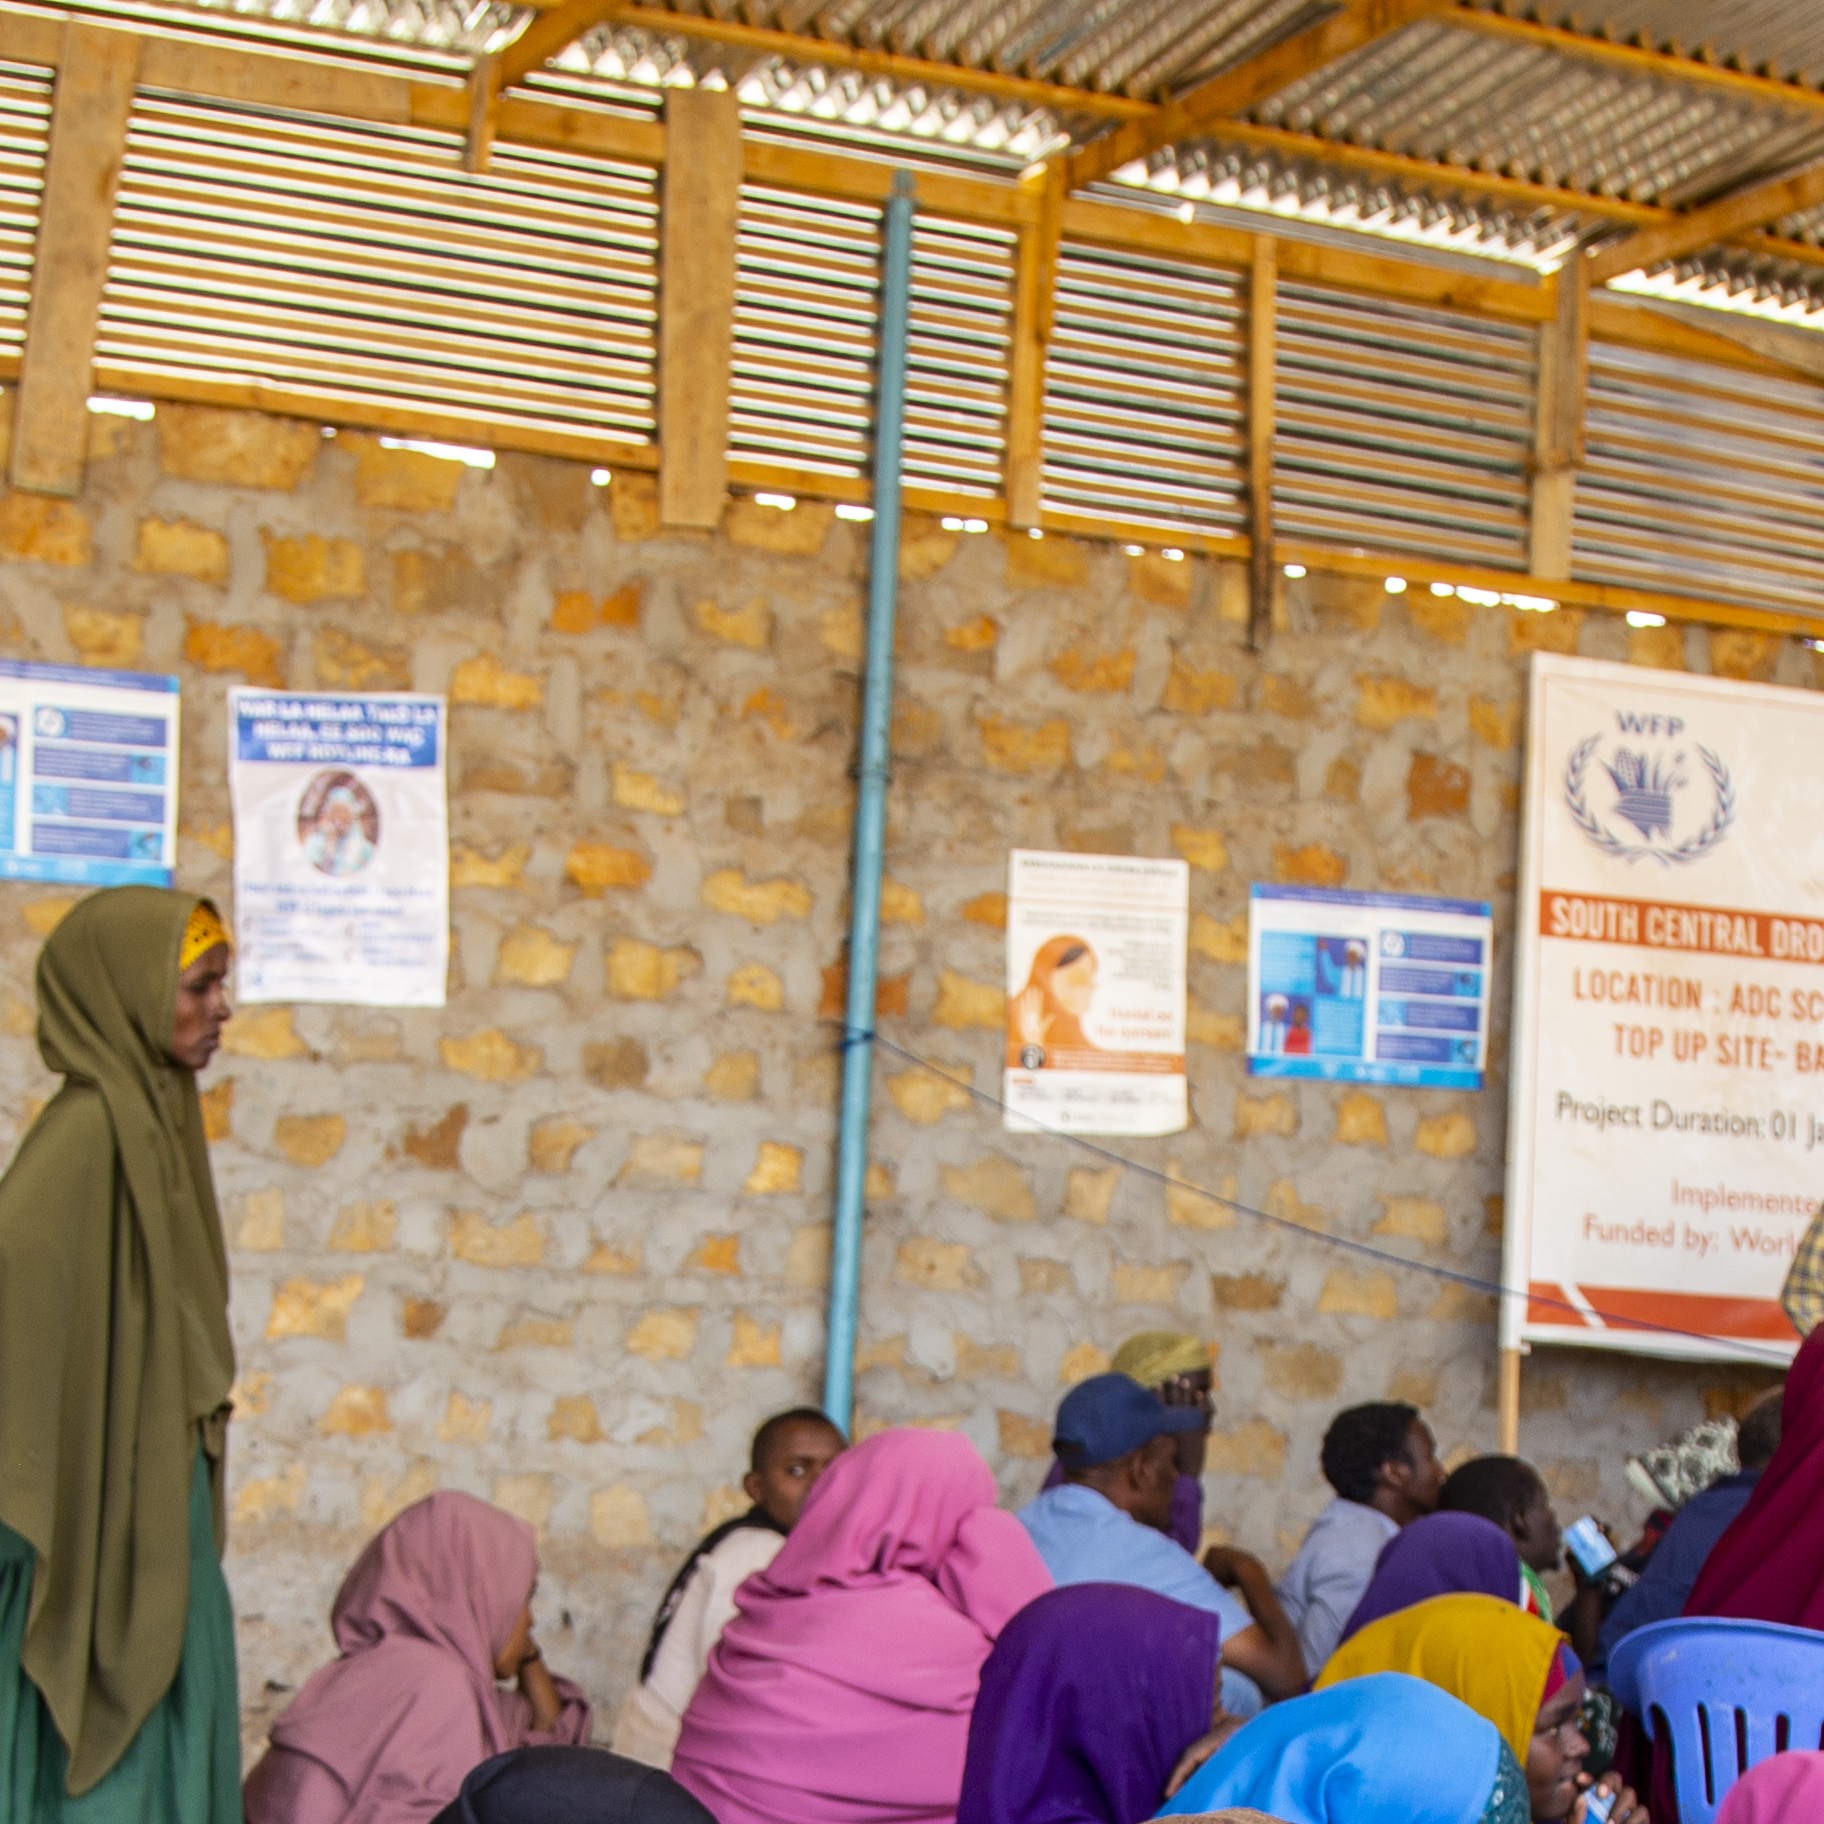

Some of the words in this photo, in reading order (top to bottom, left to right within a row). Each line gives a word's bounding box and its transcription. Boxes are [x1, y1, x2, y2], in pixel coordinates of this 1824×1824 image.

[1616, 710, 1685, 738] WFP
[1550, 897, 1638, 942] SOUTH
[1646, 906, 1763, 956] CENTRAL
[1574, 968, 1702, 1009] LOCATION
[1730, 984, 1781, 1020] ADC
[1613, 1024, 1664, 1057] TOP
[1674, 1030, 1706, 1062] UP
[1718, 1034, 1787, 1071] SITE-
[1555, 1091, 1642, 1131] Project
[1651, 1098, 1764, 1138] Duration:
[1770, 1111, 1796, 1140] 01
[1670, 1178, 1821, 1214] Implemente
[1582, 1212, 1676, 1248] Funded
[1682, 1222, 1720, 1258] by:
